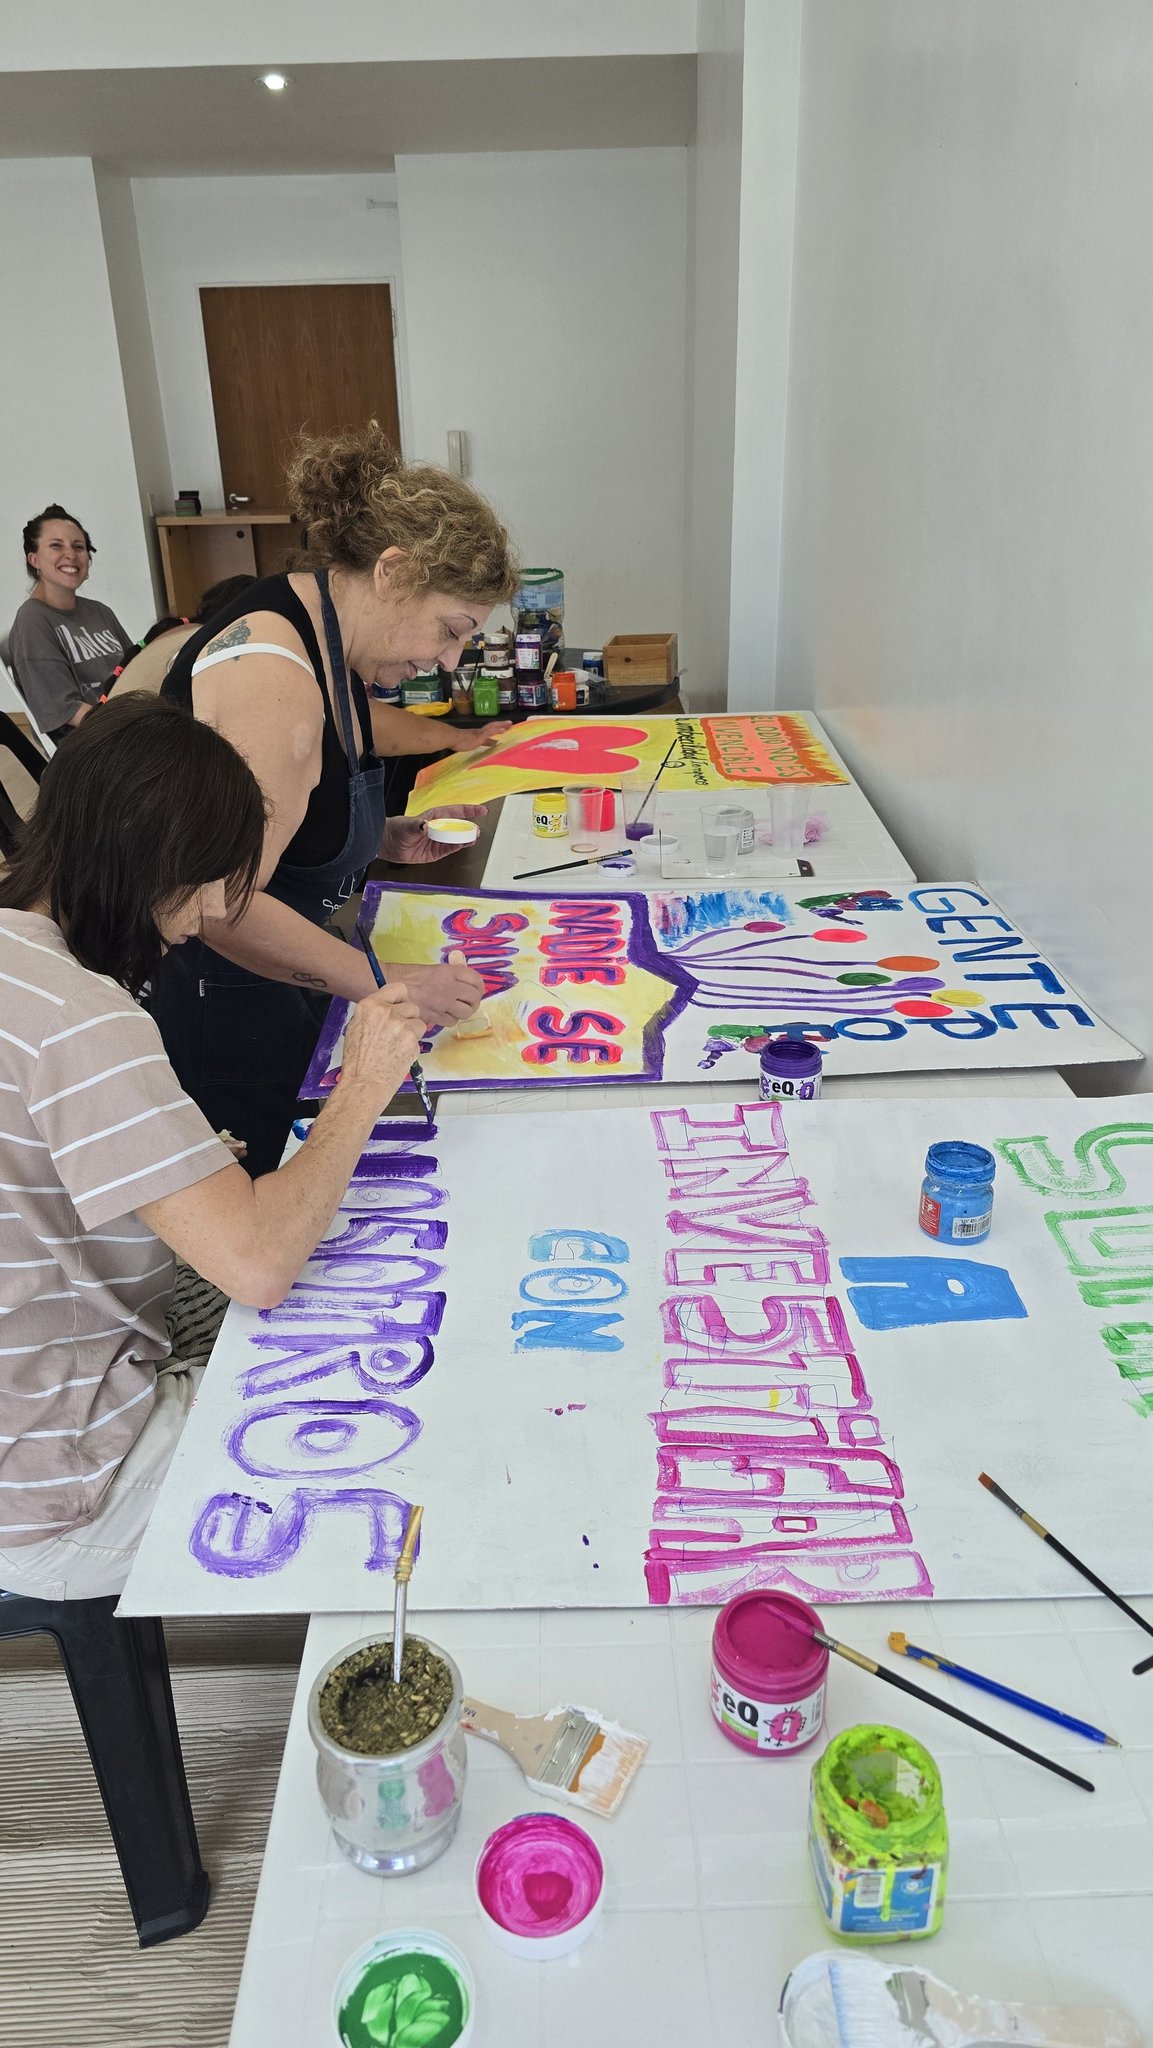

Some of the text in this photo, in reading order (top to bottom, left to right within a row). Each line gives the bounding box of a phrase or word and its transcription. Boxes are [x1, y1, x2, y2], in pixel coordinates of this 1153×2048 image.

[907, 887, 1096, 1030] GENTE
[520, 1004, 627, 1067] SE
[771, 1081, 795, 1096] eQ
[511, 1228, 631, 1353] CON
[838, 1256, 1030, 1331] A
[722, 1692, 759, 1727] eQ
